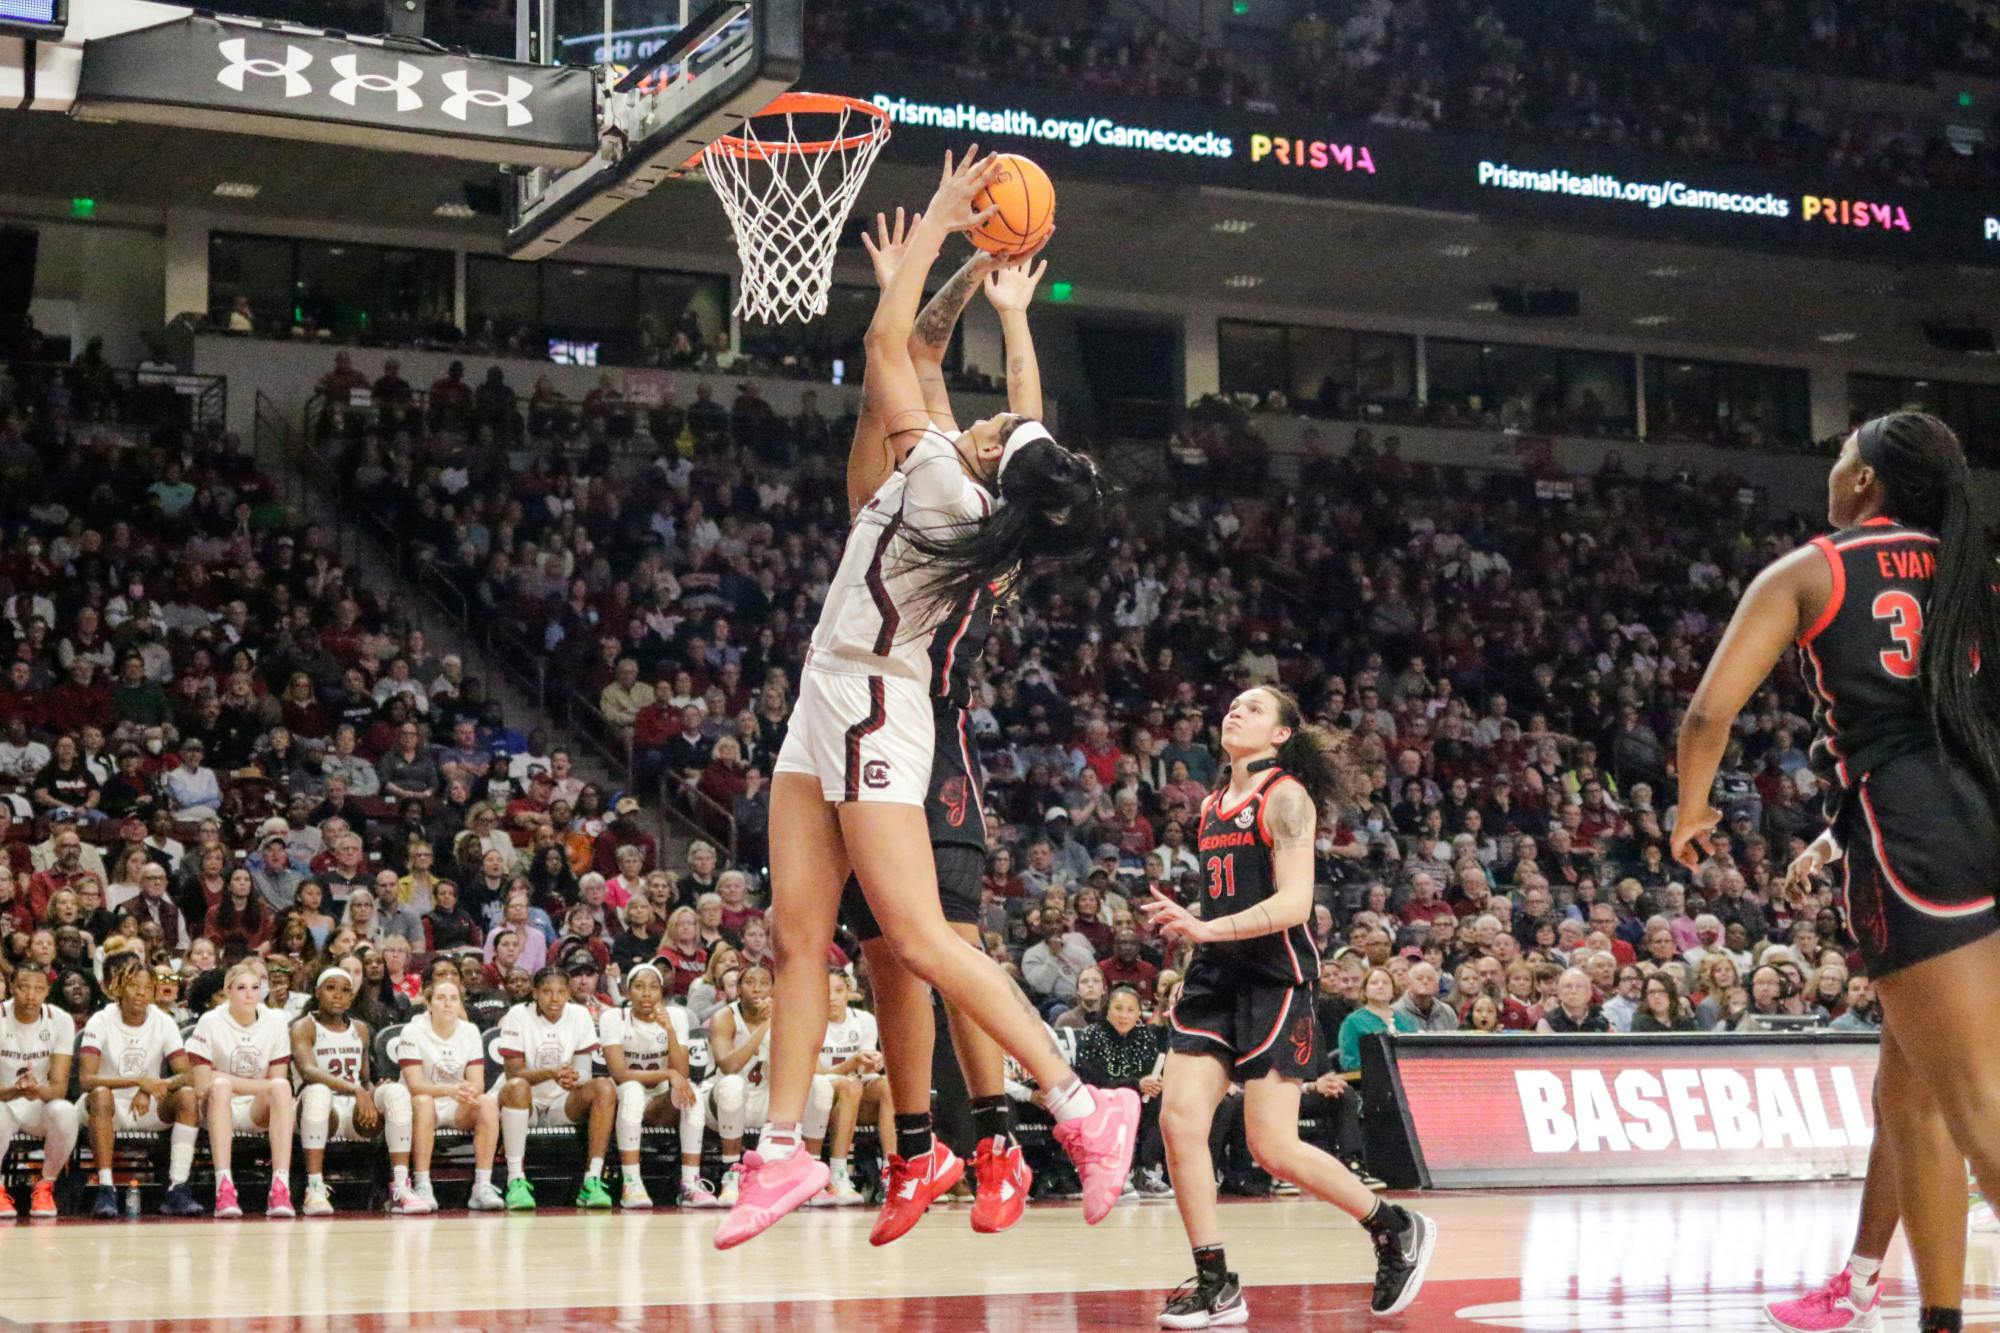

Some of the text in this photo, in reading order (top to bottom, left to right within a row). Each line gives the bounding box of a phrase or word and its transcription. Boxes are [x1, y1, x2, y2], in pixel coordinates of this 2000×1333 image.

[872, 93, 1377, 174] PrismaHealth.org/Gamecocks PRISMA
[1478, 161, 1911, 232] PrismaHealth.org/Gamecocks PRISMA
[1207, 853, 1235, 899] 31
[328, 1058, 356, 1084] 25
[1514, 1066, 1874, 1153] BASEBALL
